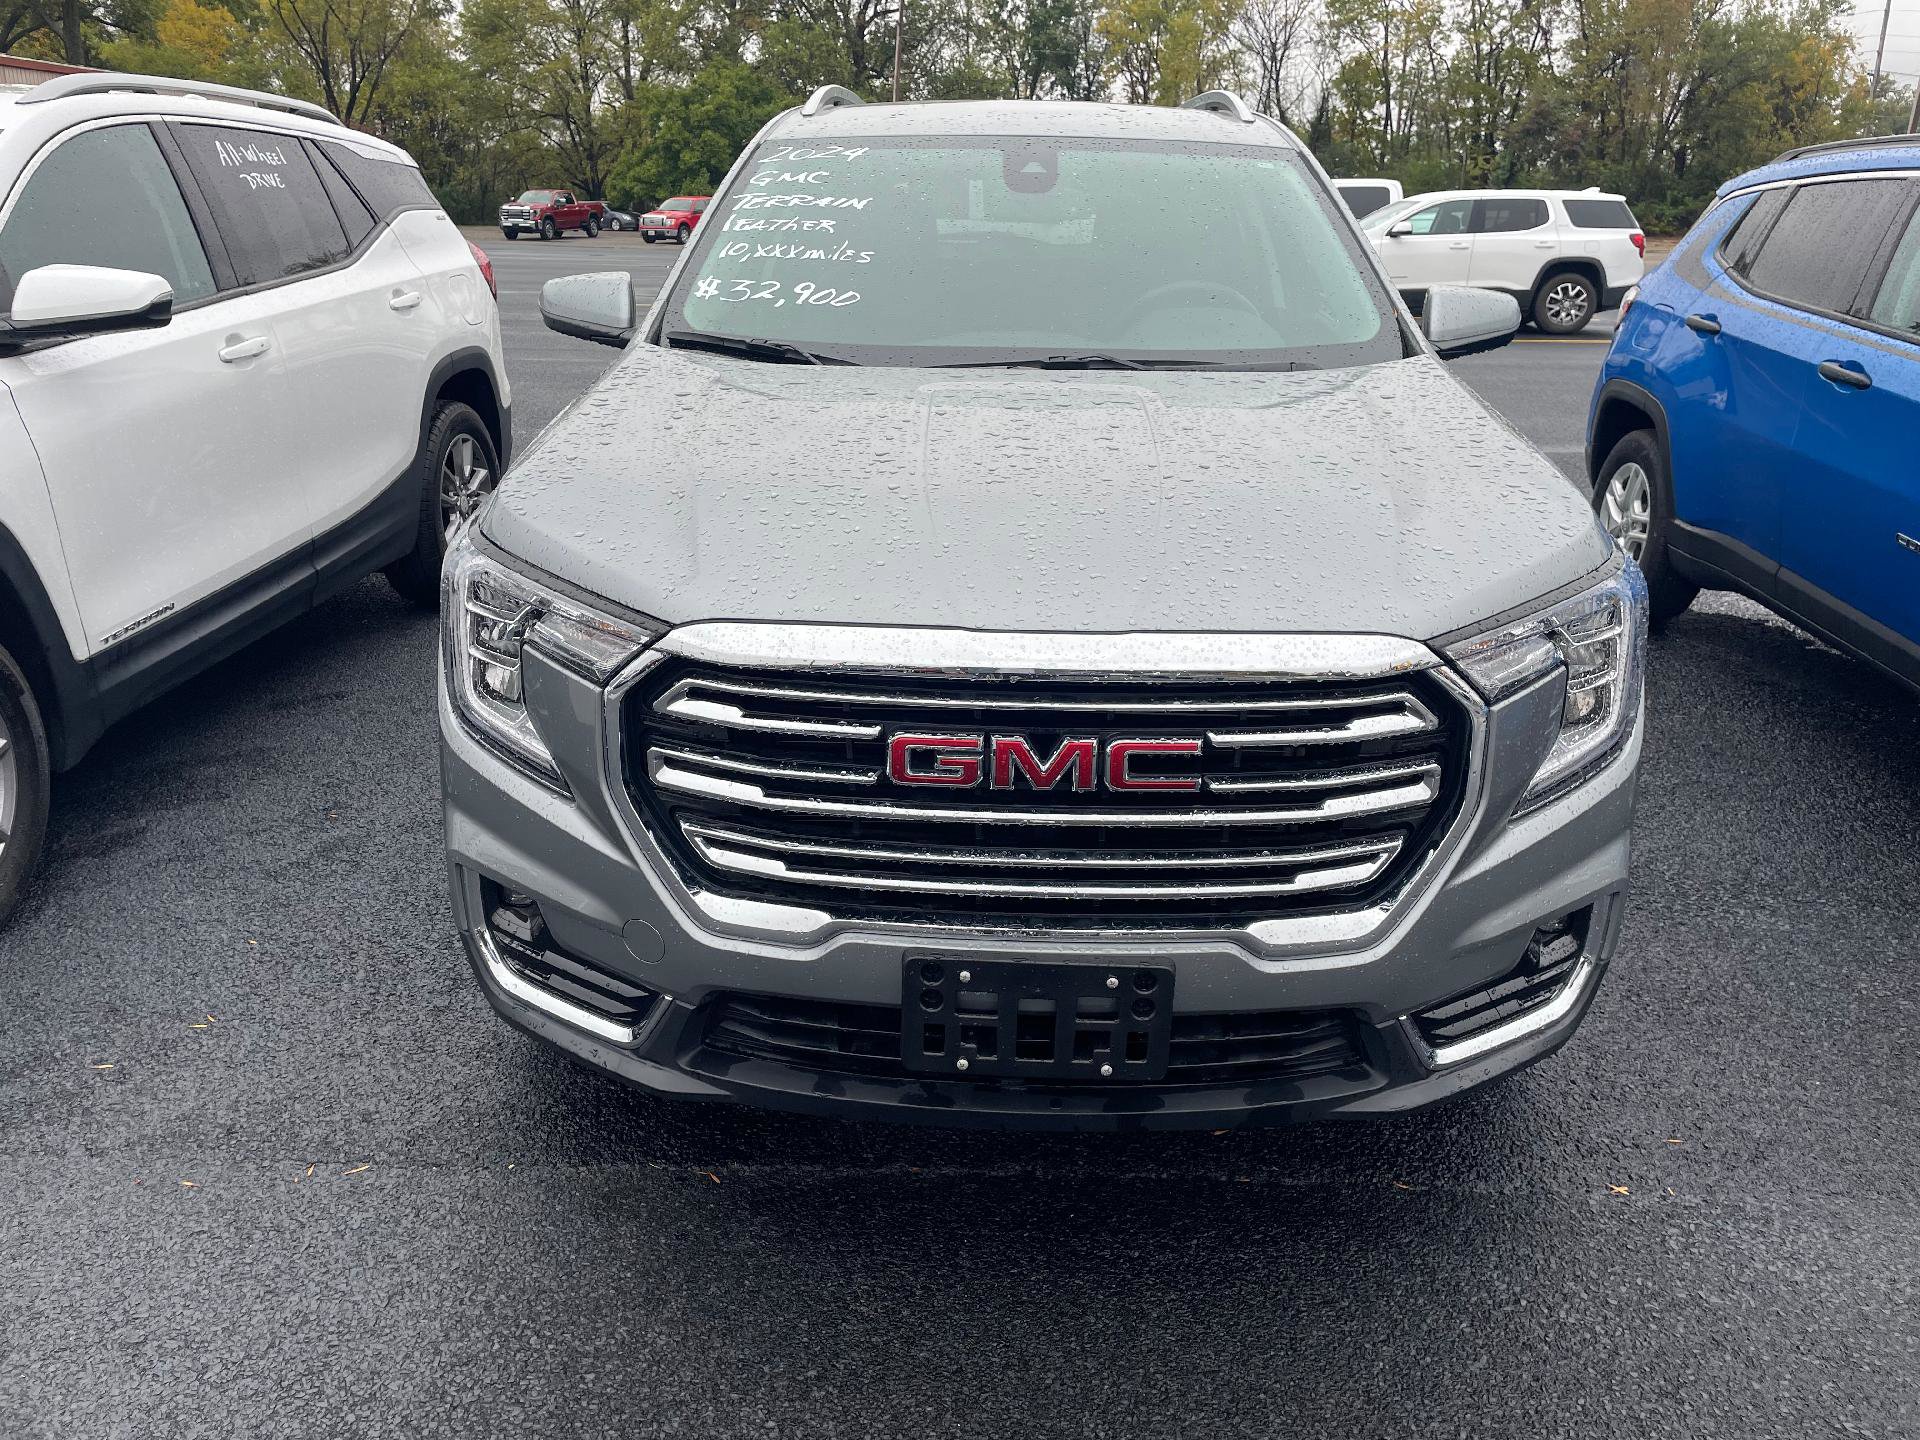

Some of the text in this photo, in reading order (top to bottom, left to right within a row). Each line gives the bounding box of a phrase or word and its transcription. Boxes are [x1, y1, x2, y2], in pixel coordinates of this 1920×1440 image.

[758, 146, 870, 164] 2024
[239, 172, 285, 190] DRIVE
[750, 170, 830, 187] GMC
[732, 192, 874, 211] TERRAIN
[693, 275, 862, 308] $32,900
[99, 602, 175, 645] TERRAIN
[886, 731, 1204, 793] GMC
